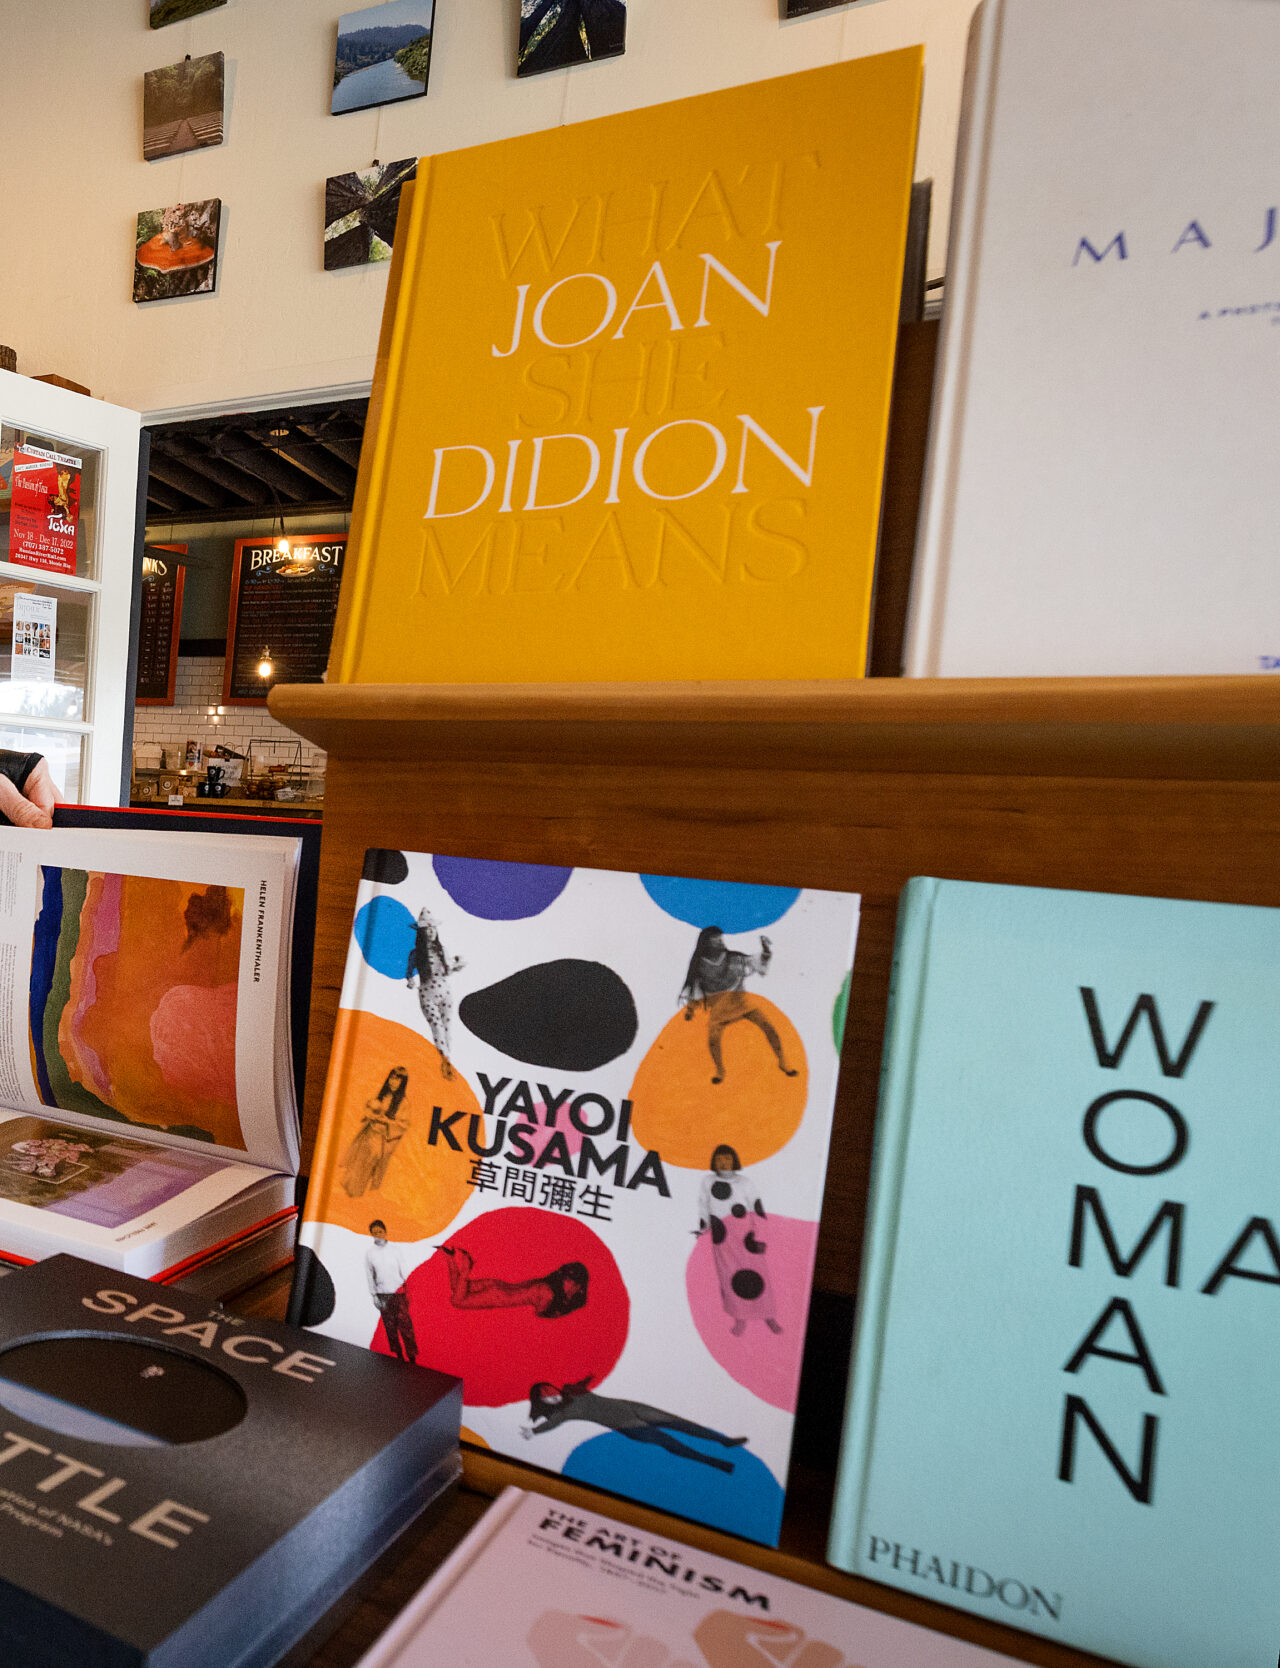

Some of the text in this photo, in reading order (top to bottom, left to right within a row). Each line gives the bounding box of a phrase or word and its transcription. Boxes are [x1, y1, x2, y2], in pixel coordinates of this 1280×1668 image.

[488, 150, 822, 280] WHAT
[491, 241, 783, 358] JOAN
[515, 333, 731, 429] SHE
[423, 406, 826, 520] DIDION
[13, 528, 25, 539] Nov
[26, 531, 34, 541] 18
[40, 534, 51, 545] Dec
[60, 539, 74, 550] 2022
[250, 545, 344, 571] BREAKFAST
[411, 498, 811, 600] MEANS
[253, 880, 267, 983] HELEN FRANKENTHALER
[426, 1106, 672, 1199] KUSAMA
[475, 1071, 634, 1143] YAYOI
[466, 1158, 615, 1223] 草間彌生
[81, 1289, 337, 1384] SPACE
[0, 1500, 64, 1539] Program
[36, 1506, 57, 1518] of
[548, 1508, 684, 1561] THE ART OF
[538, 1517, 773, 1612] FEMINISM
[866, 1534, 1064, 1621] PHAIDON
